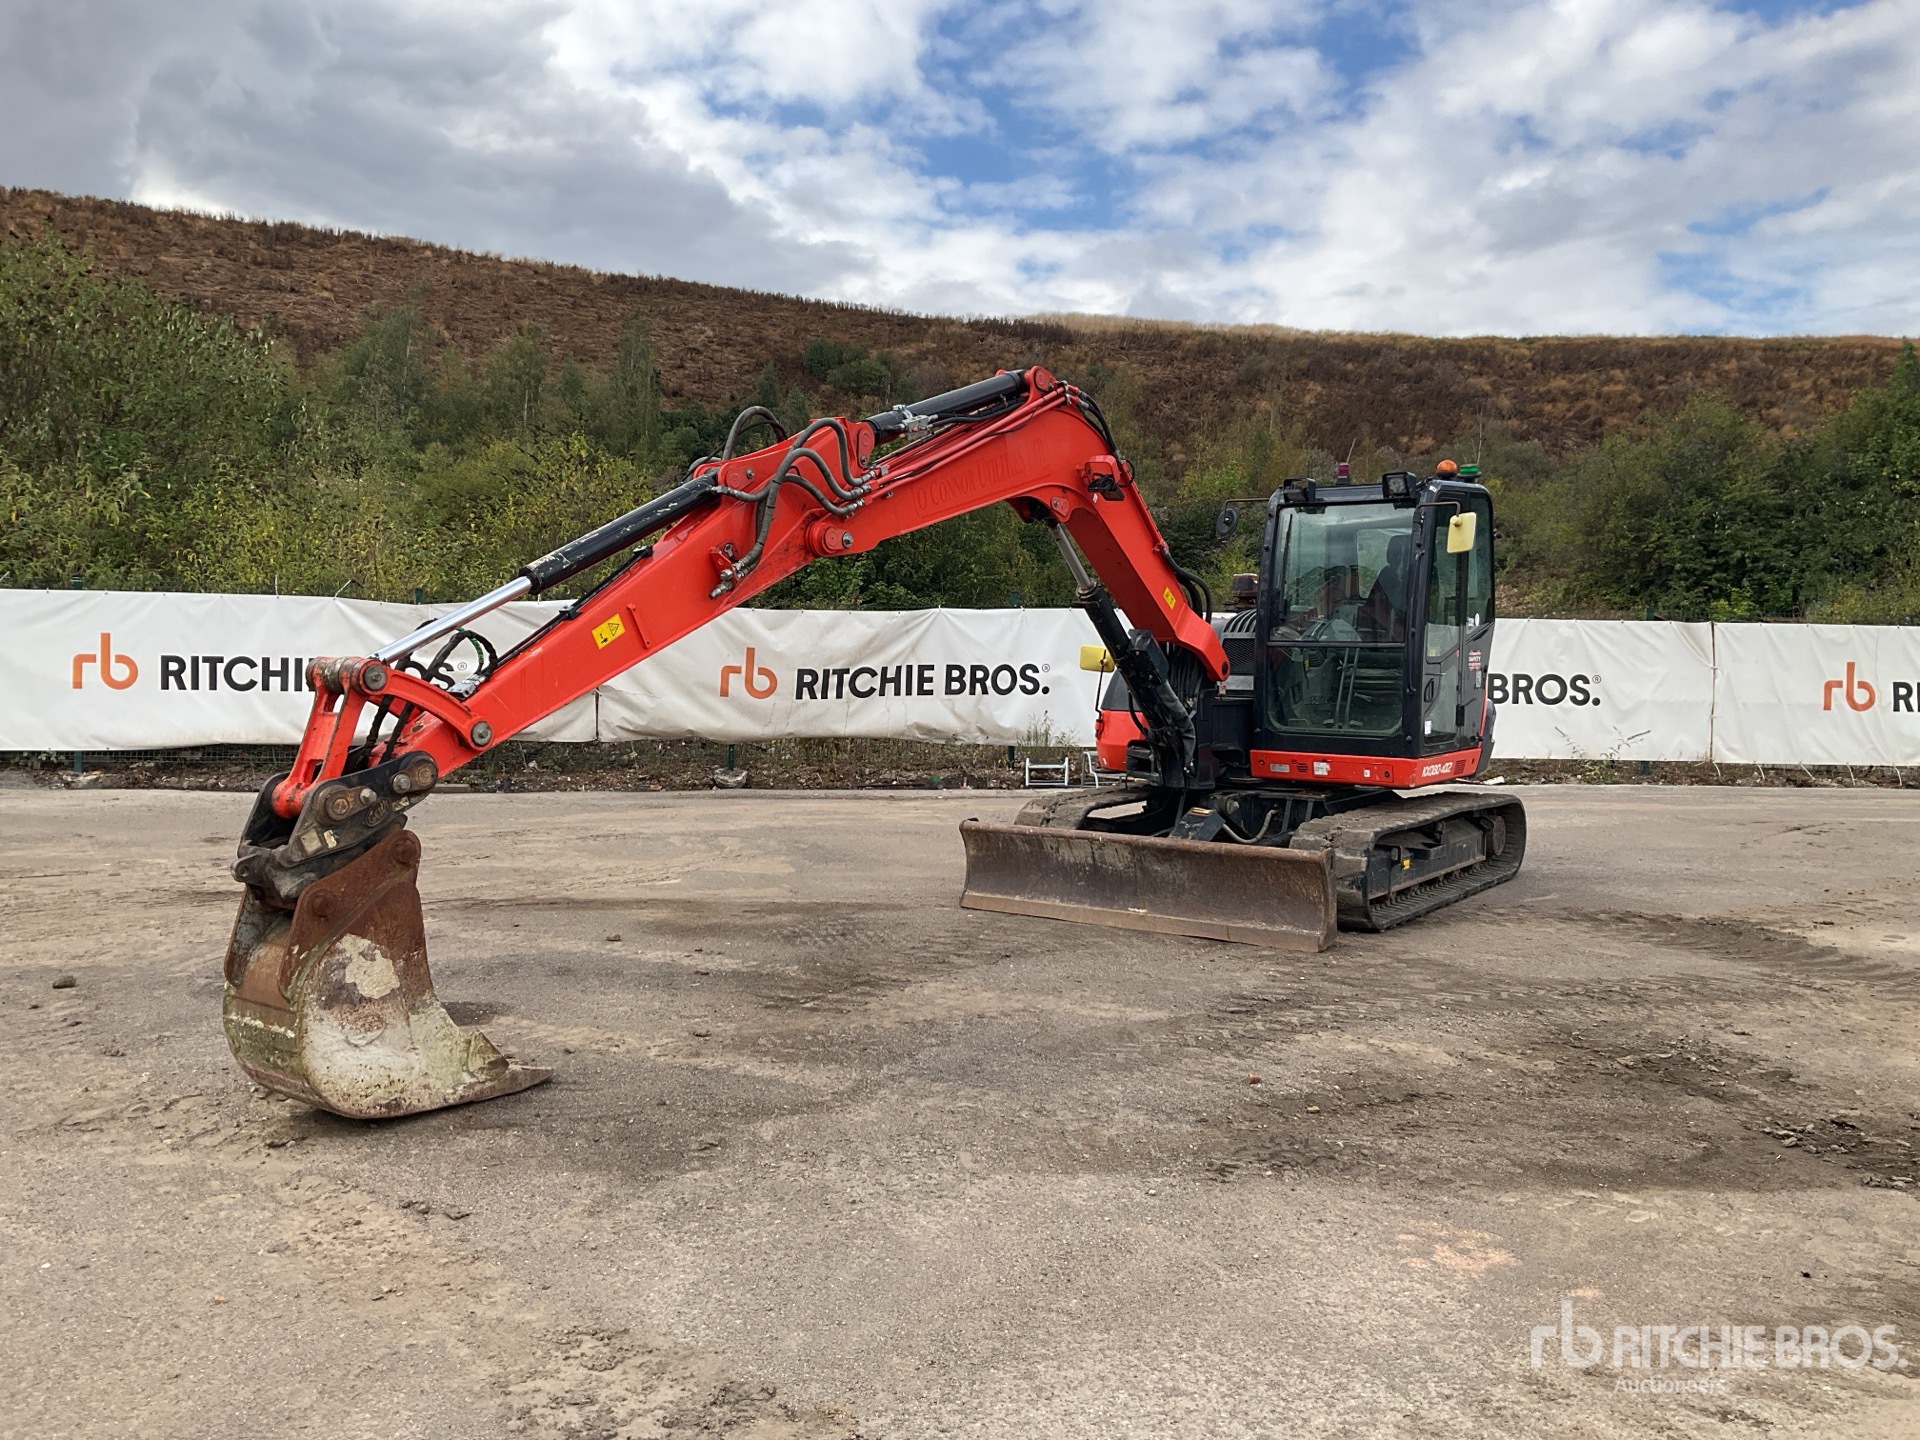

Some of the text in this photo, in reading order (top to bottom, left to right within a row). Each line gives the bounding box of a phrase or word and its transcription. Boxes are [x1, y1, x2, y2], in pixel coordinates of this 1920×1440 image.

[72, 632, 139, 690] rb
[160, 655, 314, 692] RITCHI
[719, 647, 777, 699] rb
[795, 664, 935, 700] RITCHIE
[1823, 661, 1876, 711] rb
